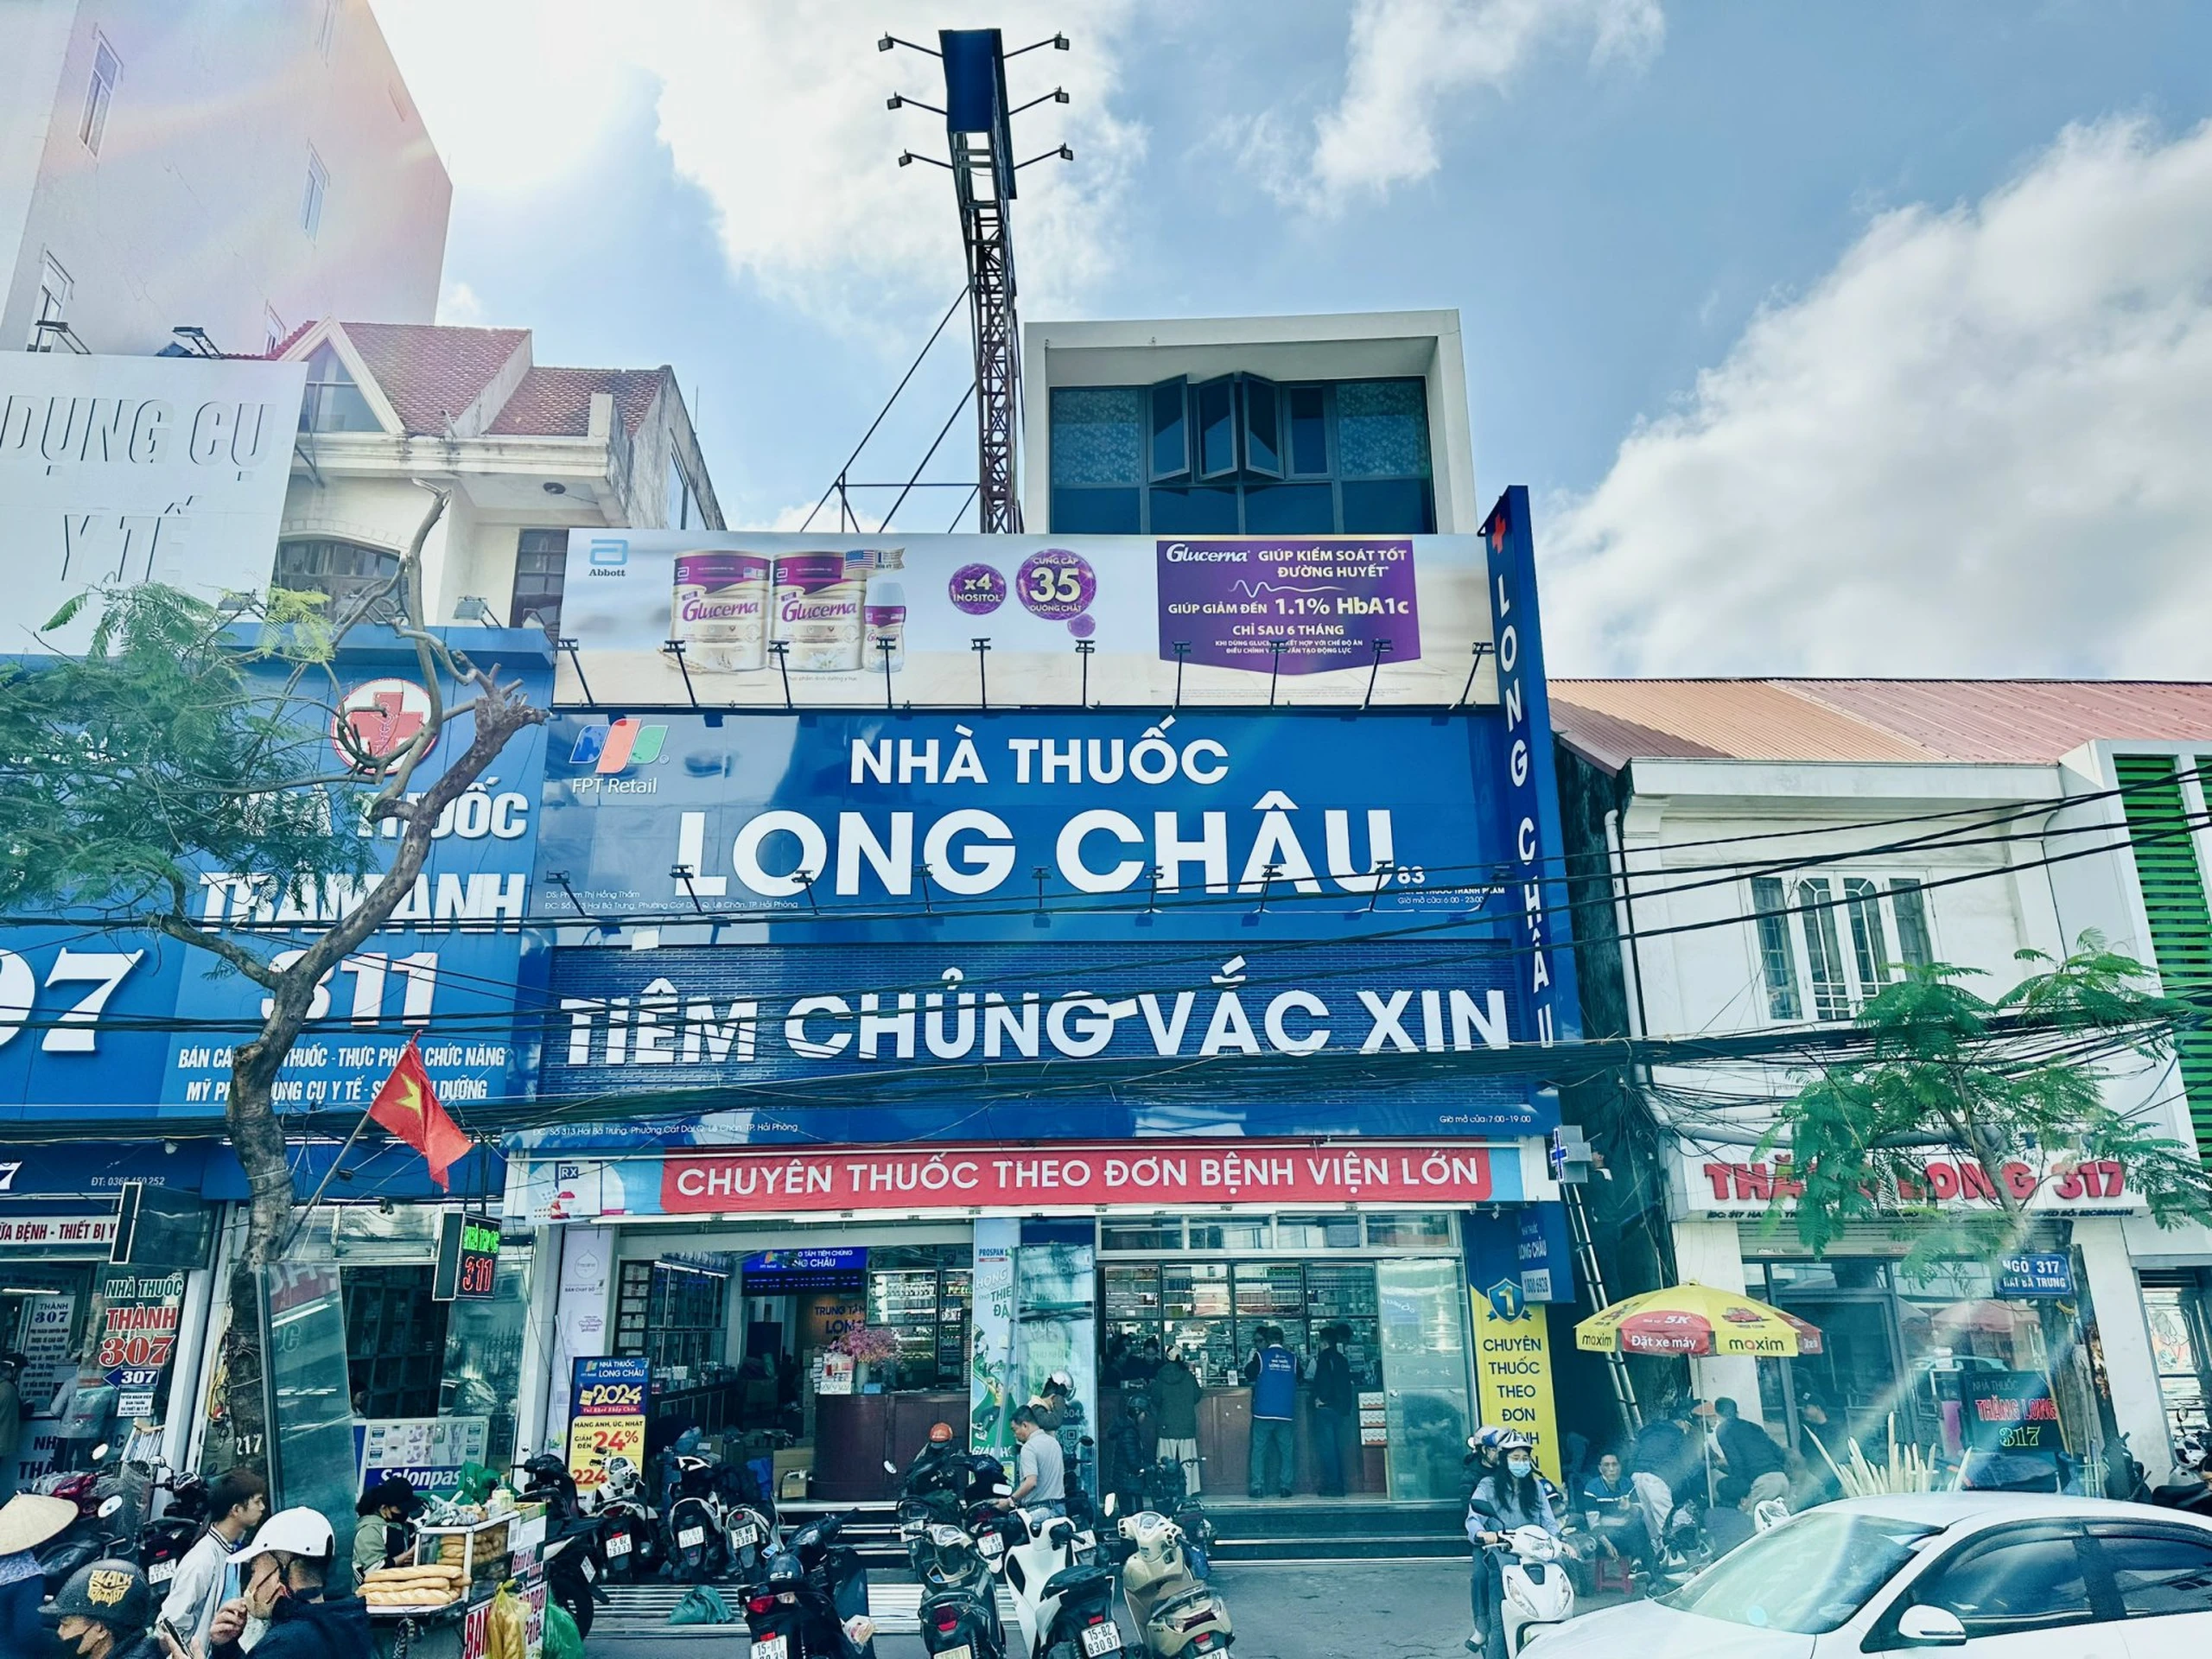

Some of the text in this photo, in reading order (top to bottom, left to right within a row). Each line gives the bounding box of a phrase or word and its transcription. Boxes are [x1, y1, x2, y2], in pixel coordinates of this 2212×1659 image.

[1258, 549, 1294, 561] GIÚP
[1297, 546, 1333, 561] KIỂM
[1336, 547, 1376, 561] SOÁT
[1377, 546, 1407, 561] TỐT
[589, 569, 626, 577] Abbott
[1277, 565, 1333, 577] ĐƯỜNG
[964, 573, 992, 590] x4
[1030, 567, 1081, 602] 35
[953, 594, 1001, 602] INOSITOL
[1168, 596, 1409, 615] GIÚP GIẢM ĐẾN 1.1% HbA1c
[682, 599, 760, 622] Glucerna
[781, 599, 857, 623] Glucerna
[1232, 623, 1344, 636] CHỈ SAU 6 THÁNG
[1497, 574, 1529, 787] LONG
[850, 715, 1229, 785] NHÀ THUỐC
[571, 778, 658, 794] FPT Retail
[675, 790, 1395, 897] LONG CHÂU
[561, 955, 1509, 1065] TIÊM CHỦNG VẮC XIN
[178, 1046, 209, 1069] BÁN
[338, 1047, 374, 1069] THỰC
[424, 1046, 462, 1067] CHỨC
[465, 1045, 505, 1066] NĂNG
[186, 1074, 487, 1103] MỸ CỤ Y TẾ DƯỠNG
[91, 1177, 105, 1186] ĐT:
[562, 1167, 577, 1178] RX
[677, 1148, 1478, 1198] CHUYÊN THUỐC THEO ĐƠN BỆNH VIỆN LỚN
[2051, 1160, 2126, 1199] 317
[16, 1221, 48, 1243] BỆNH
[59, 1219, 91, 1240] THIẾT
[93, 1223, 105, 1242] BỊ
[462, 1255, 493, 1292] 311
[2037, 1261, 2059, 1274] 317
[105, 1273, 184, 1298] NHÀ THUỐC
[2037, 1276, 2066, 1288] TRƯNG
[35, 1312, 68, 1324] 307
[105, 1301, 178, 1332] THÀNH
[815, 1306, 845, 1316] TRUNG
[1483, 1335, 1541, 1352] CHUYÊN
[1581, 1332, 1612, 1347] maxim
[1631, 1335, 1696, 1350] Đặt xe máy
[1729, 1336, 1784, 1351] maxim
[99, 1335, 176, 1367] 307
[622, 1366, 645, 1377] CHÂU
[1488, 1356, 1541, 1375] THUỐC
[121, 1370, 157, 1383] 307
[593, 1383, 643, 1405] 2024
[1497, 1384, 1536, 1398] THEO
[1502, 1408, 1535, 1421] ĐƠN
[1975, 1394, 2020, 1421] THĂNG
[236, 1433, 263, 1455] 217
[1999, 1426, 2041, 1447] 317
